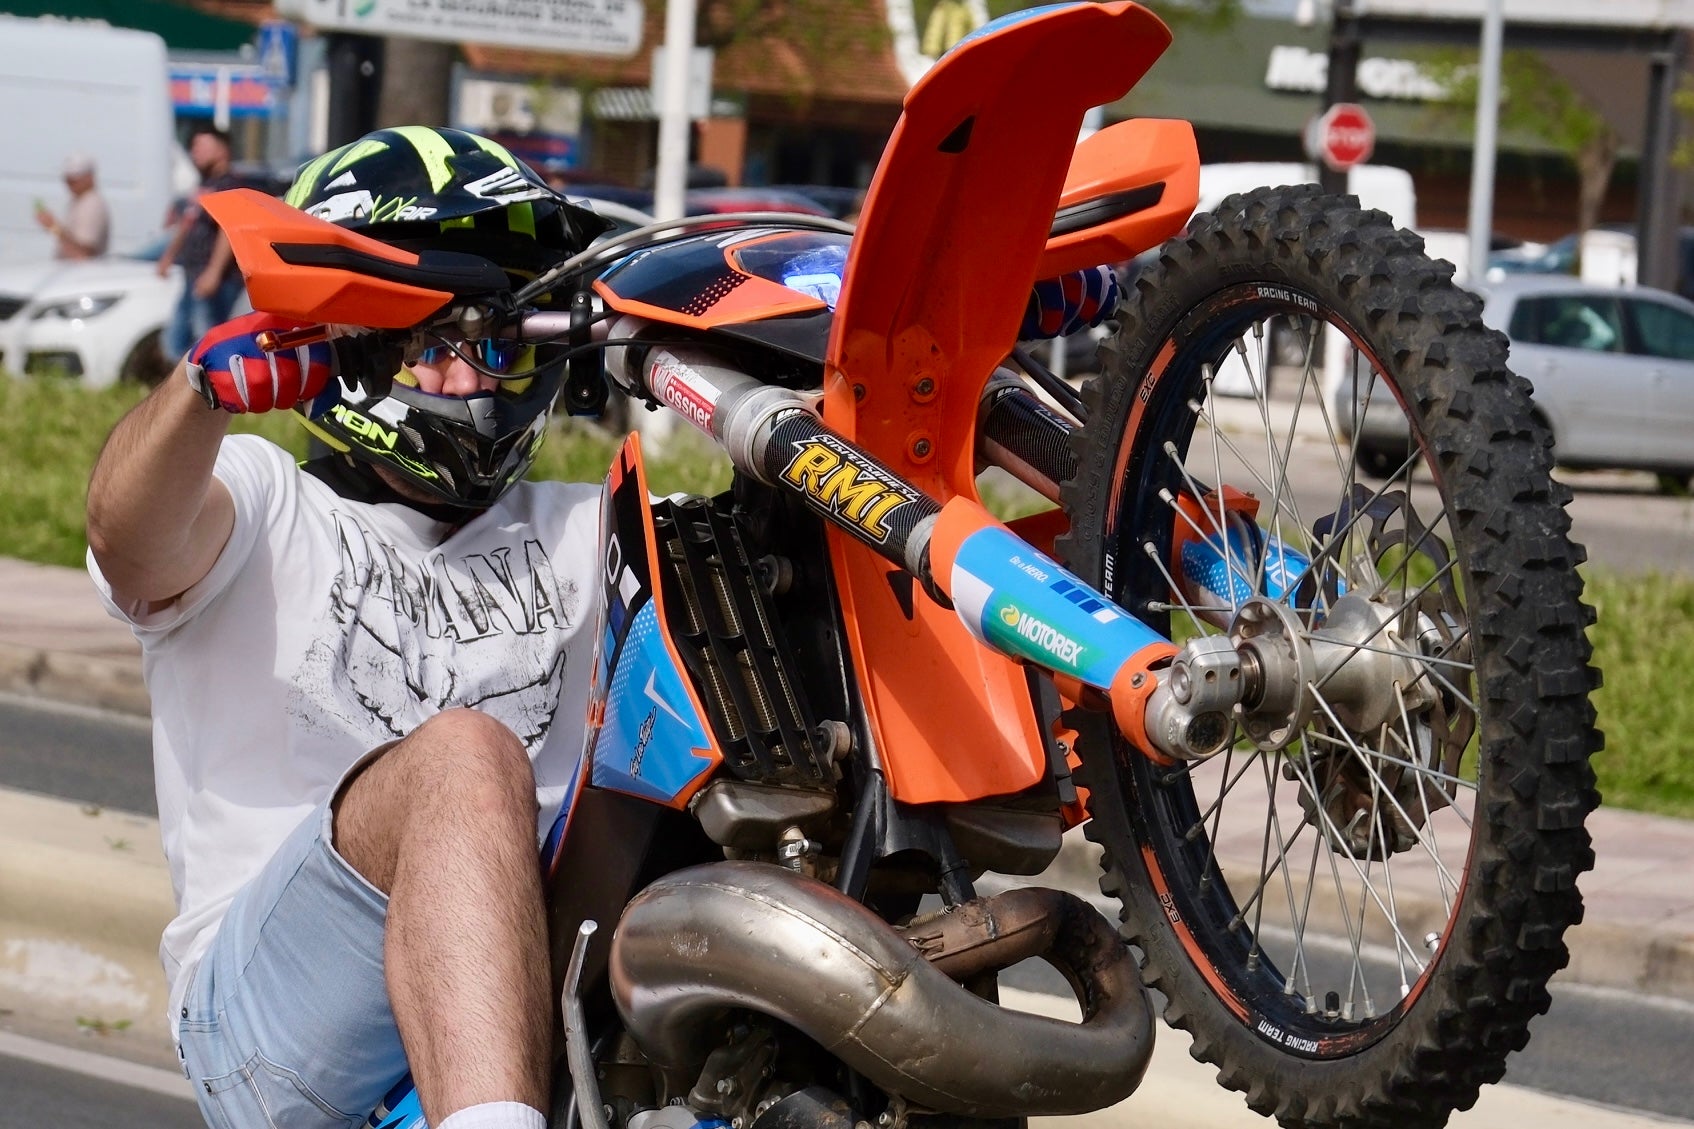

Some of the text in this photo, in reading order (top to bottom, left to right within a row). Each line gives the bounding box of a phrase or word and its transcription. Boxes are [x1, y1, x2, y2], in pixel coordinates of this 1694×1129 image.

[398, 205, 438, 221] AIR
[1257, 286, 1318, 313] RACING TEAM
[1140, 371, 1156, 404] EXC
[1104, 553, 1115, 600] TEAM
[1017, 612, 1084, 668] MOTOREX
[1160, 893, 1180, 924] EXC
[1257, 1020, 1319, 1054] RACING TEAM
